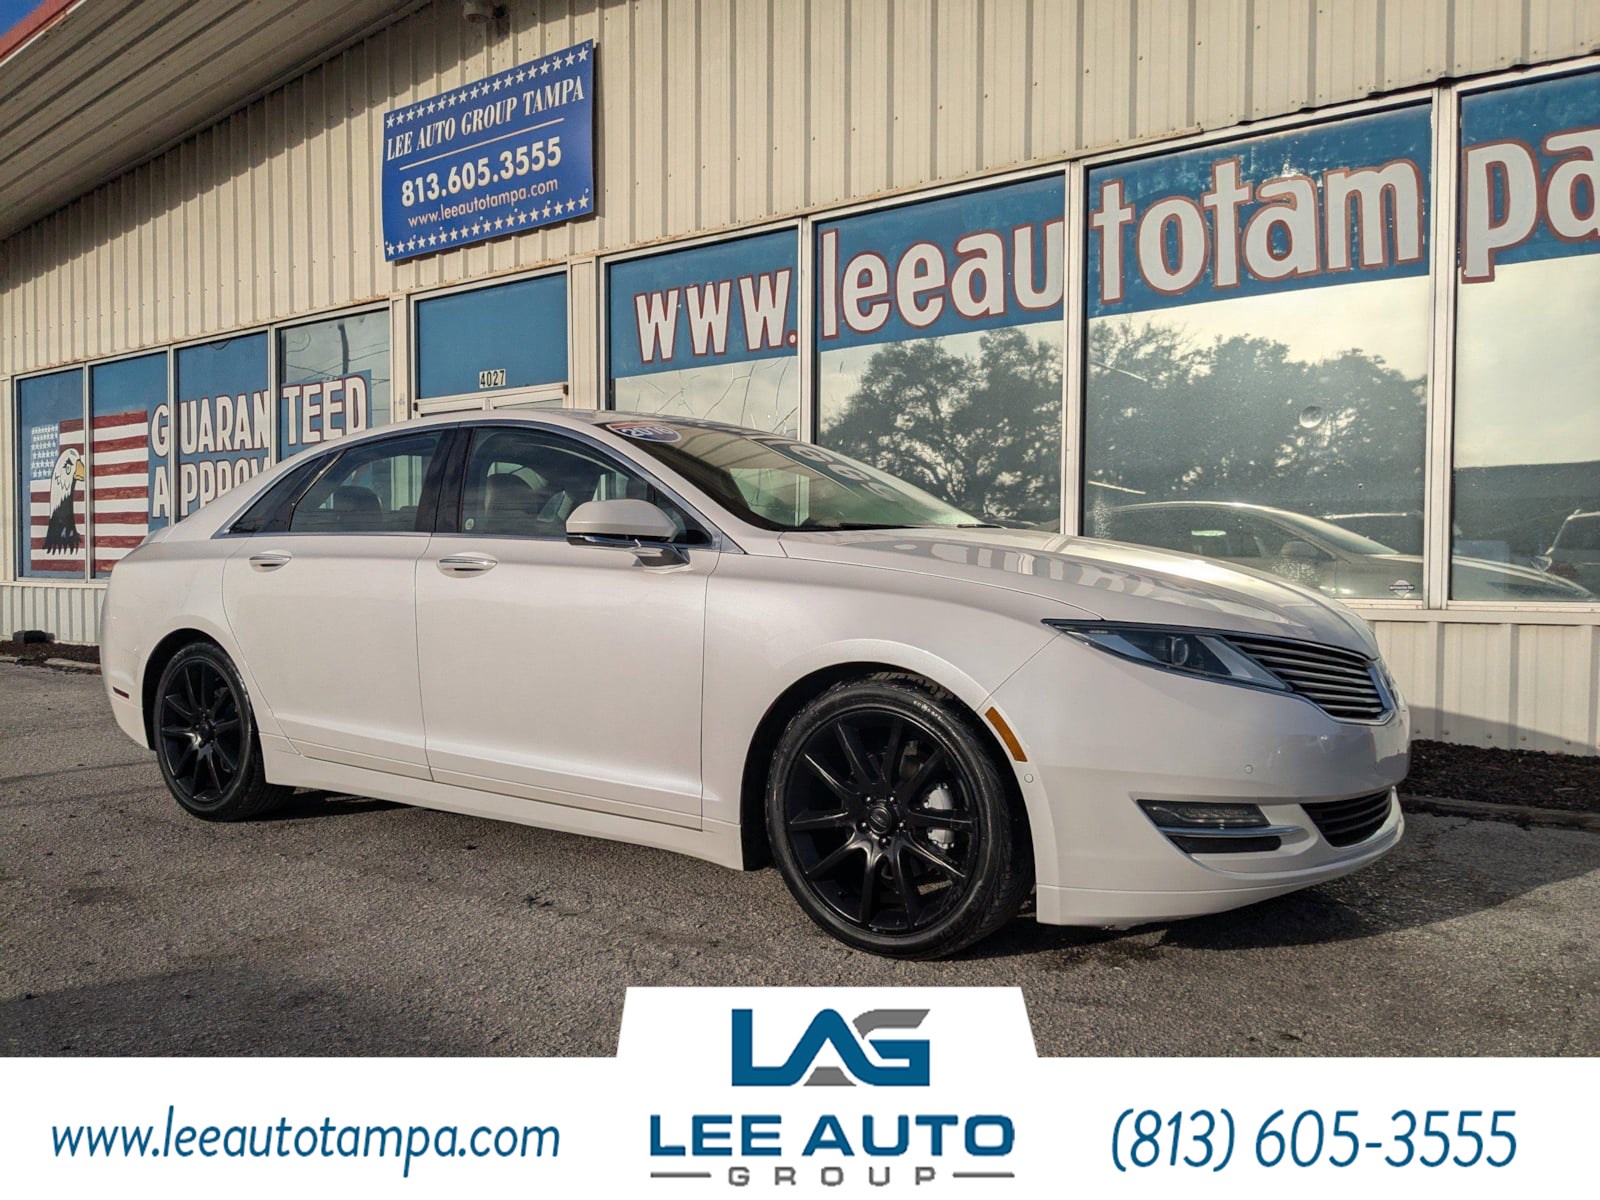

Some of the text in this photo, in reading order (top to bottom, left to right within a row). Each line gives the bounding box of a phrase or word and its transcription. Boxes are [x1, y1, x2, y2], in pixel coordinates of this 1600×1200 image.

[386, 75, 585, 161] LEE AUTO GROUP TAMPA
[401, 135, 562, 207] 813.605.3555
[407, 177, 559, 228] www.leeautotampa.com
[480, 370, 505, 387] 4027
